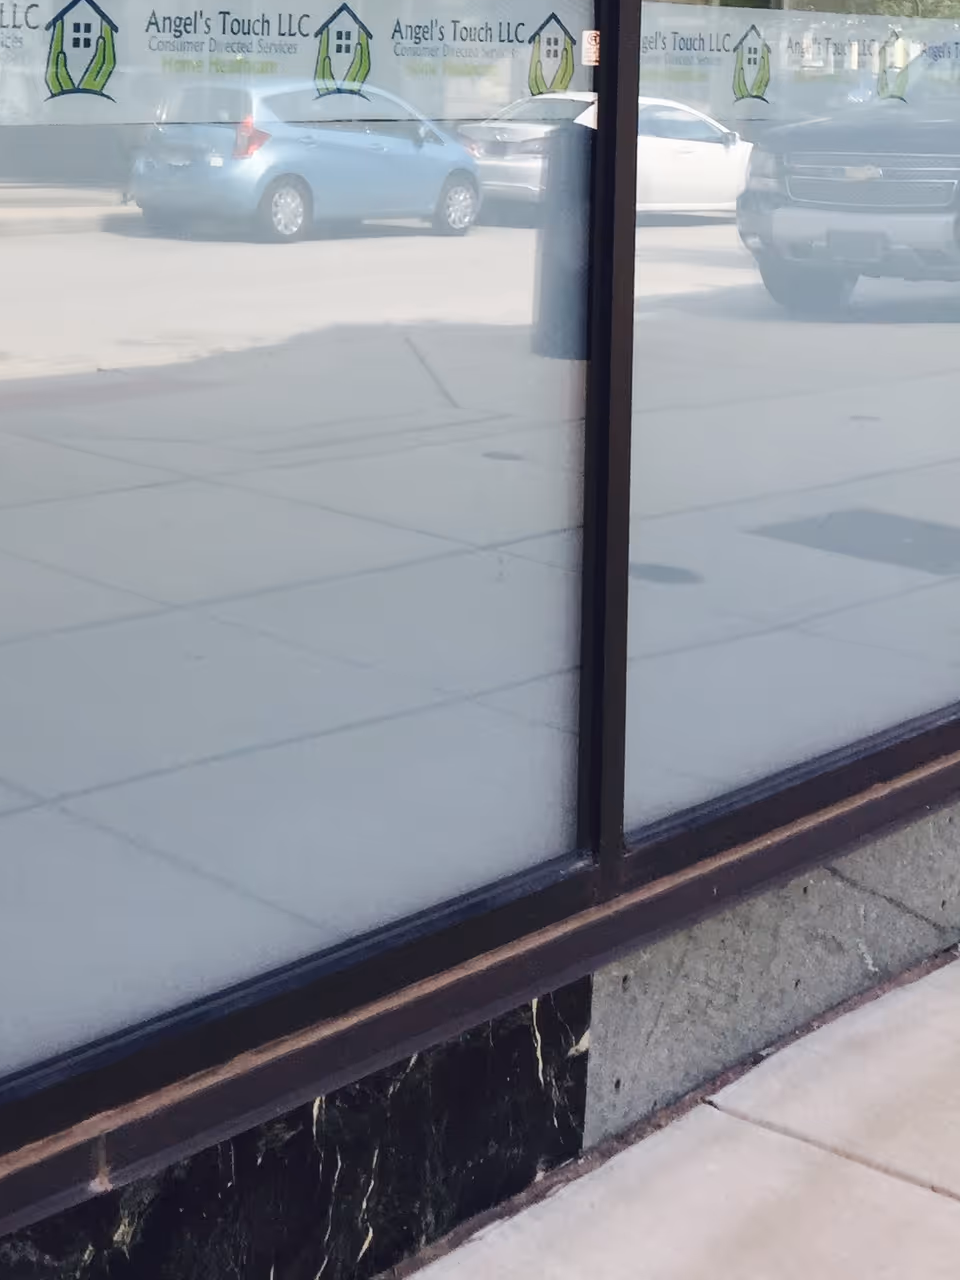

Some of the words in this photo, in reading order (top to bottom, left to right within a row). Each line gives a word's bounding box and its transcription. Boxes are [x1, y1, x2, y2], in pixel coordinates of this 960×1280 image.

[145, 9, 211, 38] Angel's
[218, 11, 270, 37] Touch
[278, 13, 310, 37] LLC
[391, 19, 445, 45] Angel's
[451, 20, 492, 43] Touch
[498, 22, 525, 43] LLC
[148, 36, 204, 52] Consumer
[257, 39, 298, 55] Services
[671, 31, 705, 51] Touch
[709, 33, 731, 52] LLC
